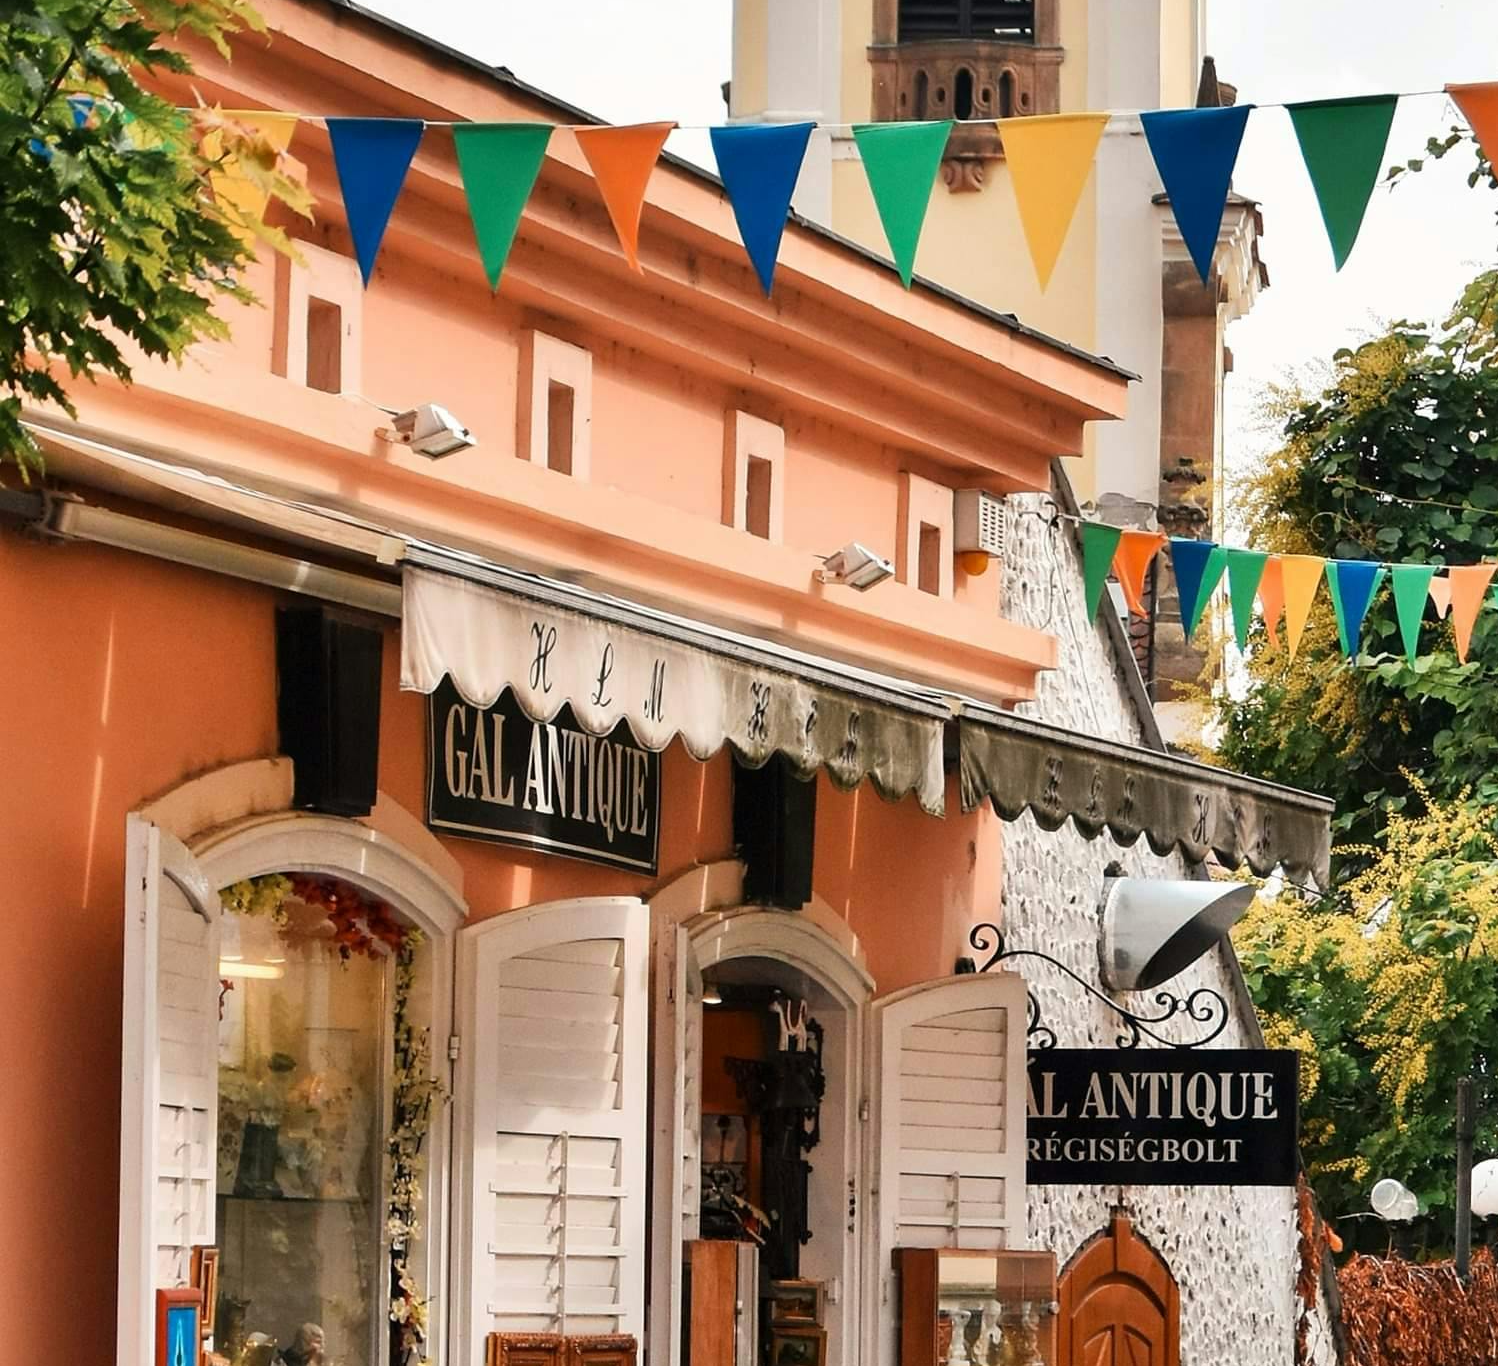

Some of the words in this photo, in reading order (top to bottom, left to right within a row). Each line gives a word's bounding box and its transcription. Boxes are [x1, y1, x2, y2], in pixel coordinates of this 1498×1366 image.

[529, 621, 557, 693] H
[444, 703, 515, 807] GAL
[522, 721, 649, 843] ANTIQUE
[1079, 1070, 1279, 1128] ANTIQUE
[1026, 1131, 1243, 1163] RÉGISÉGBOLT
